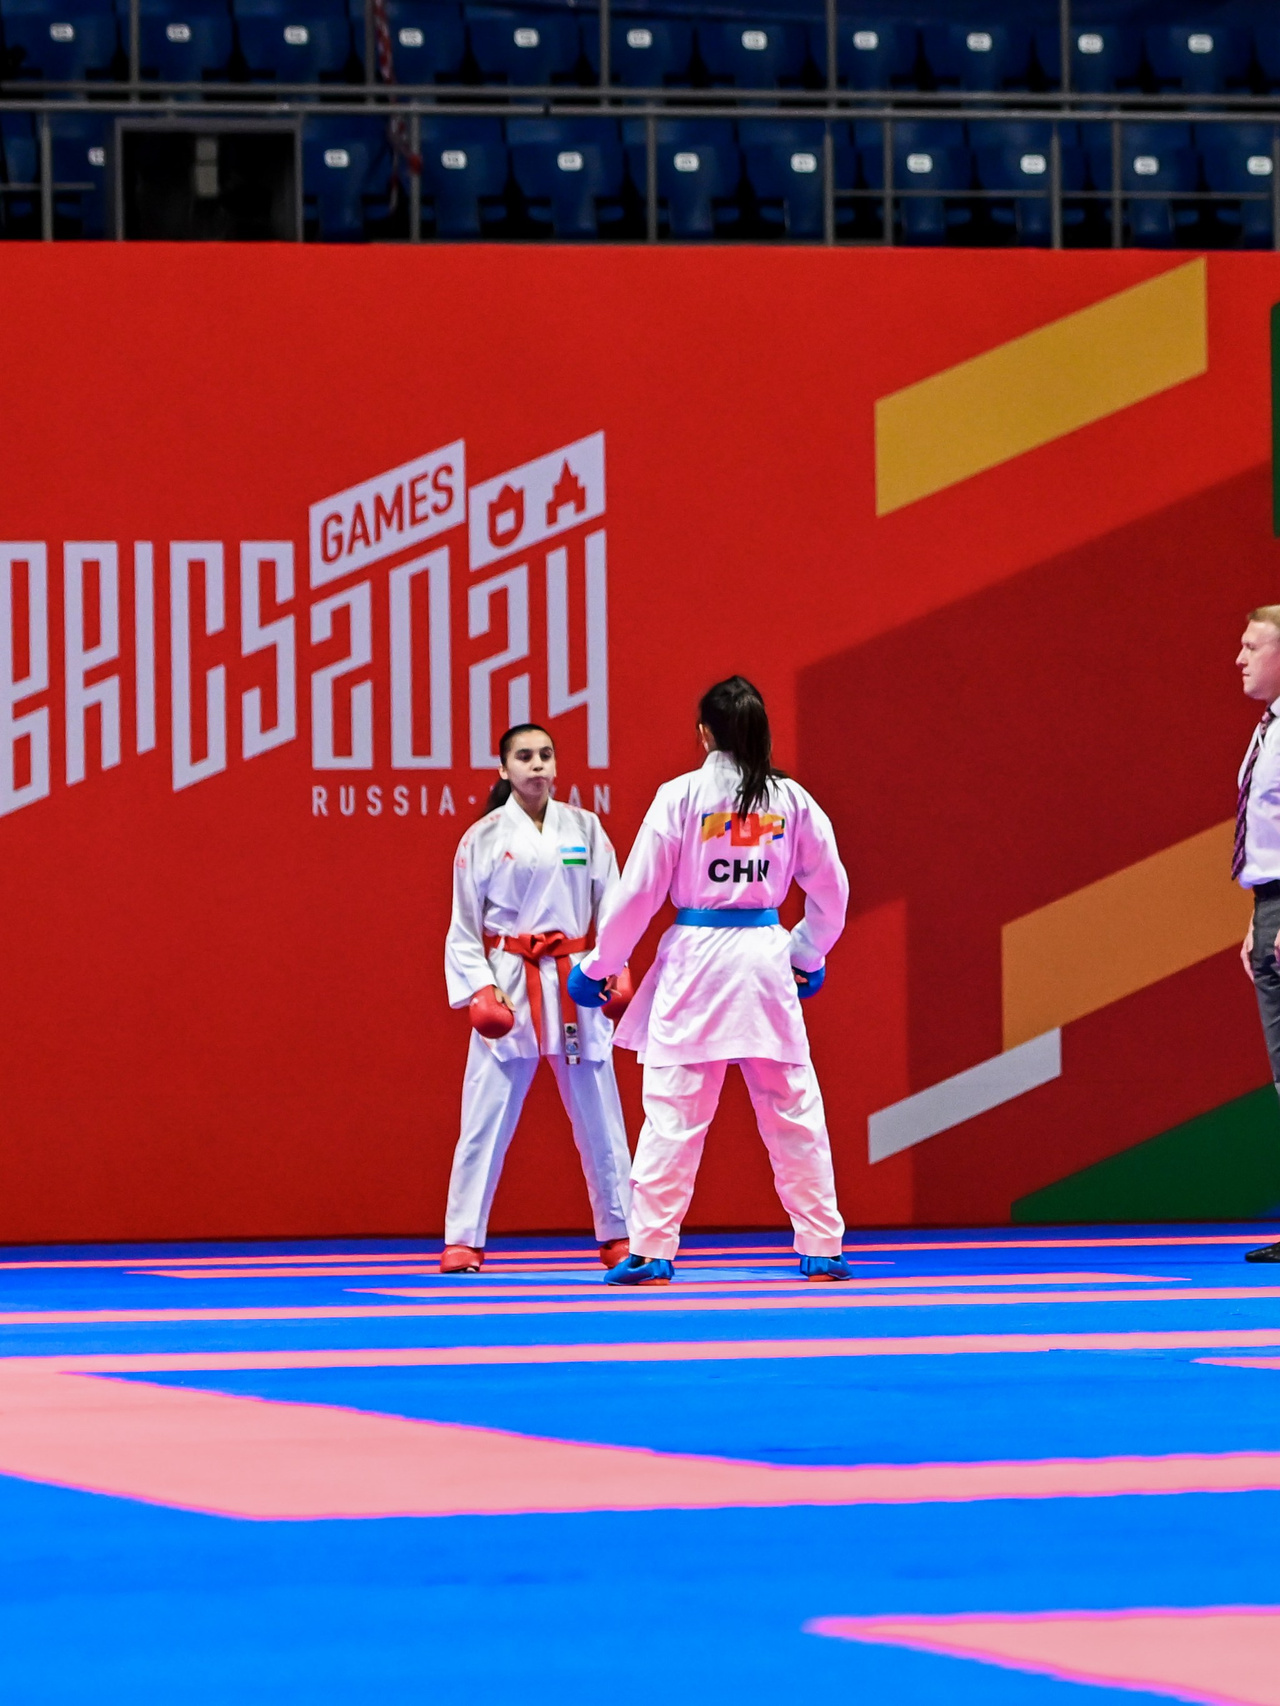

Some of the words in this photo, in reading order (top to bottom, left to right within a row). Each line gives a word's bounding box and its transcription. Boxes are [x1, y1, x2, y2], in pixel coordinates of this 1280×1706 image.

[320, 464, 453, 565] GAMES
[0, 540, 297, 818] BRICS
[310, 528, 609, 771] 2024
[312, 784, 456, 816] RUSSIA
[707, 858, 770, 883] CHN
